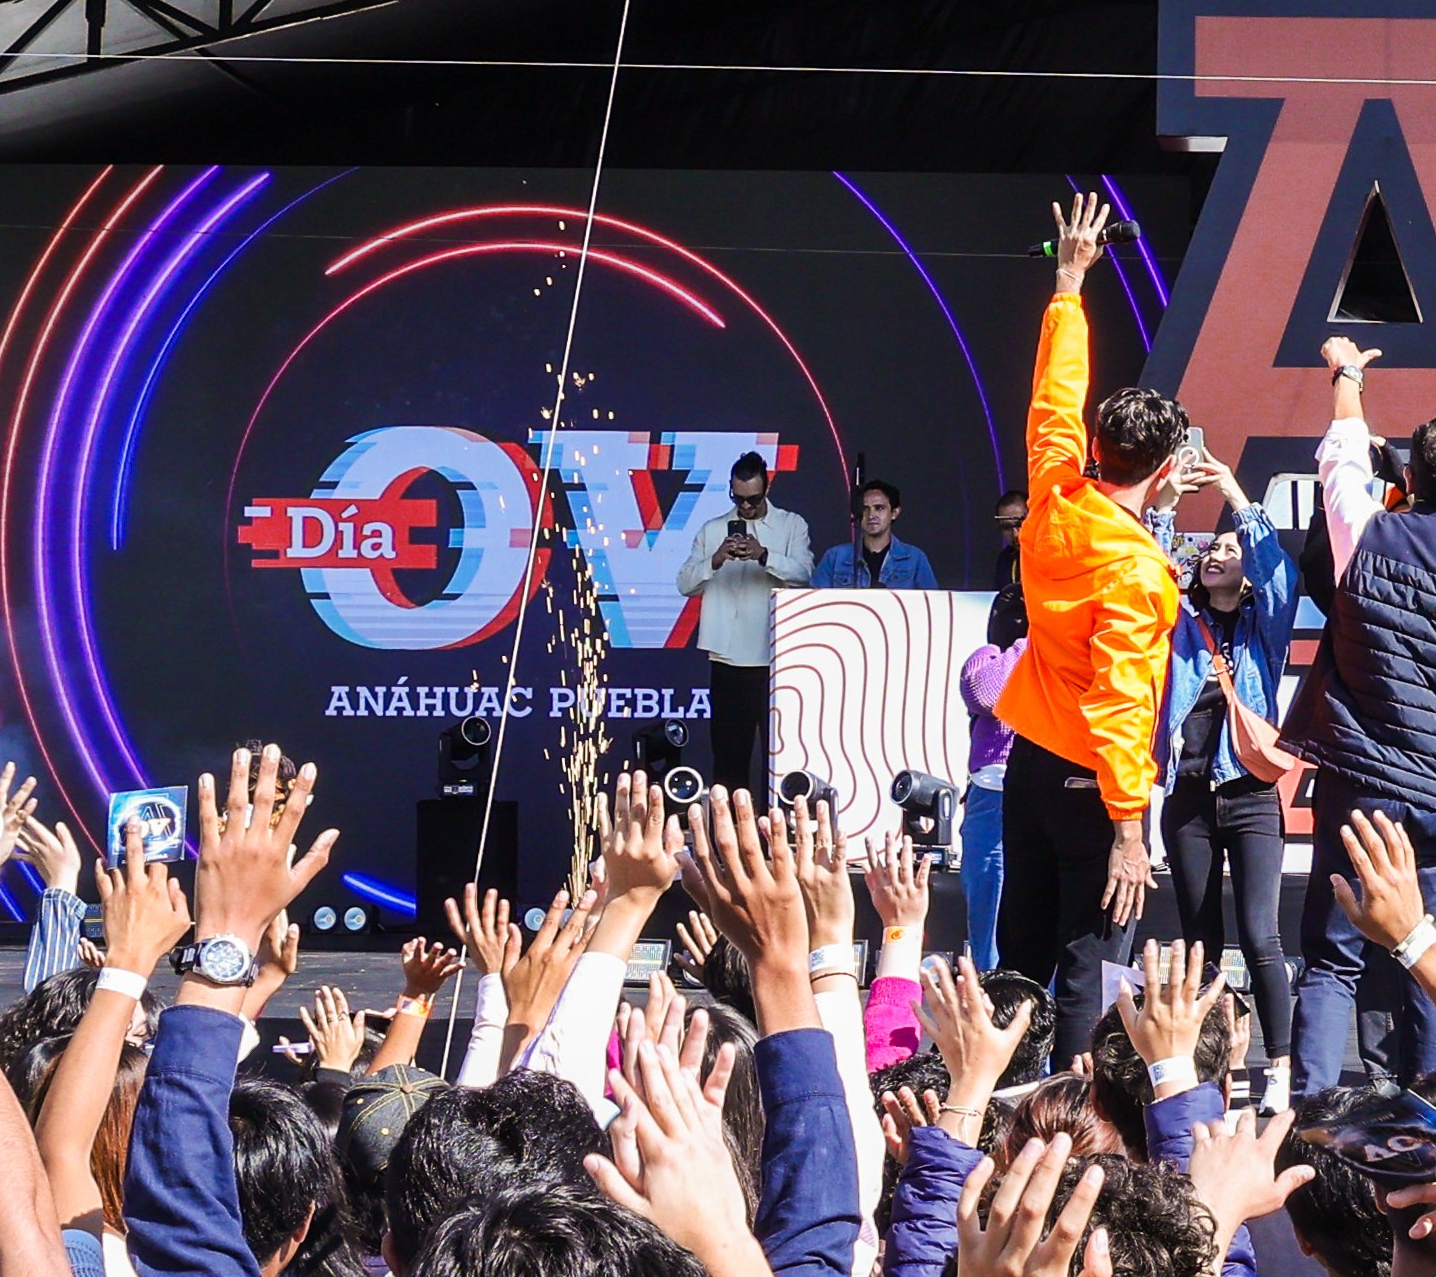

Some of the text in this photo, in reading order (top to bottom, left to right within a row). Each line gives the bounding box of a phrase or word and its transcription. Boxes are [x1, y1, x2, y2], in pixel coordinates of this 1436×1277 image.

[285, 425, 799, 650] Día OV
[324, 676, 712, 719] ANÁHUAC PUEBLA
